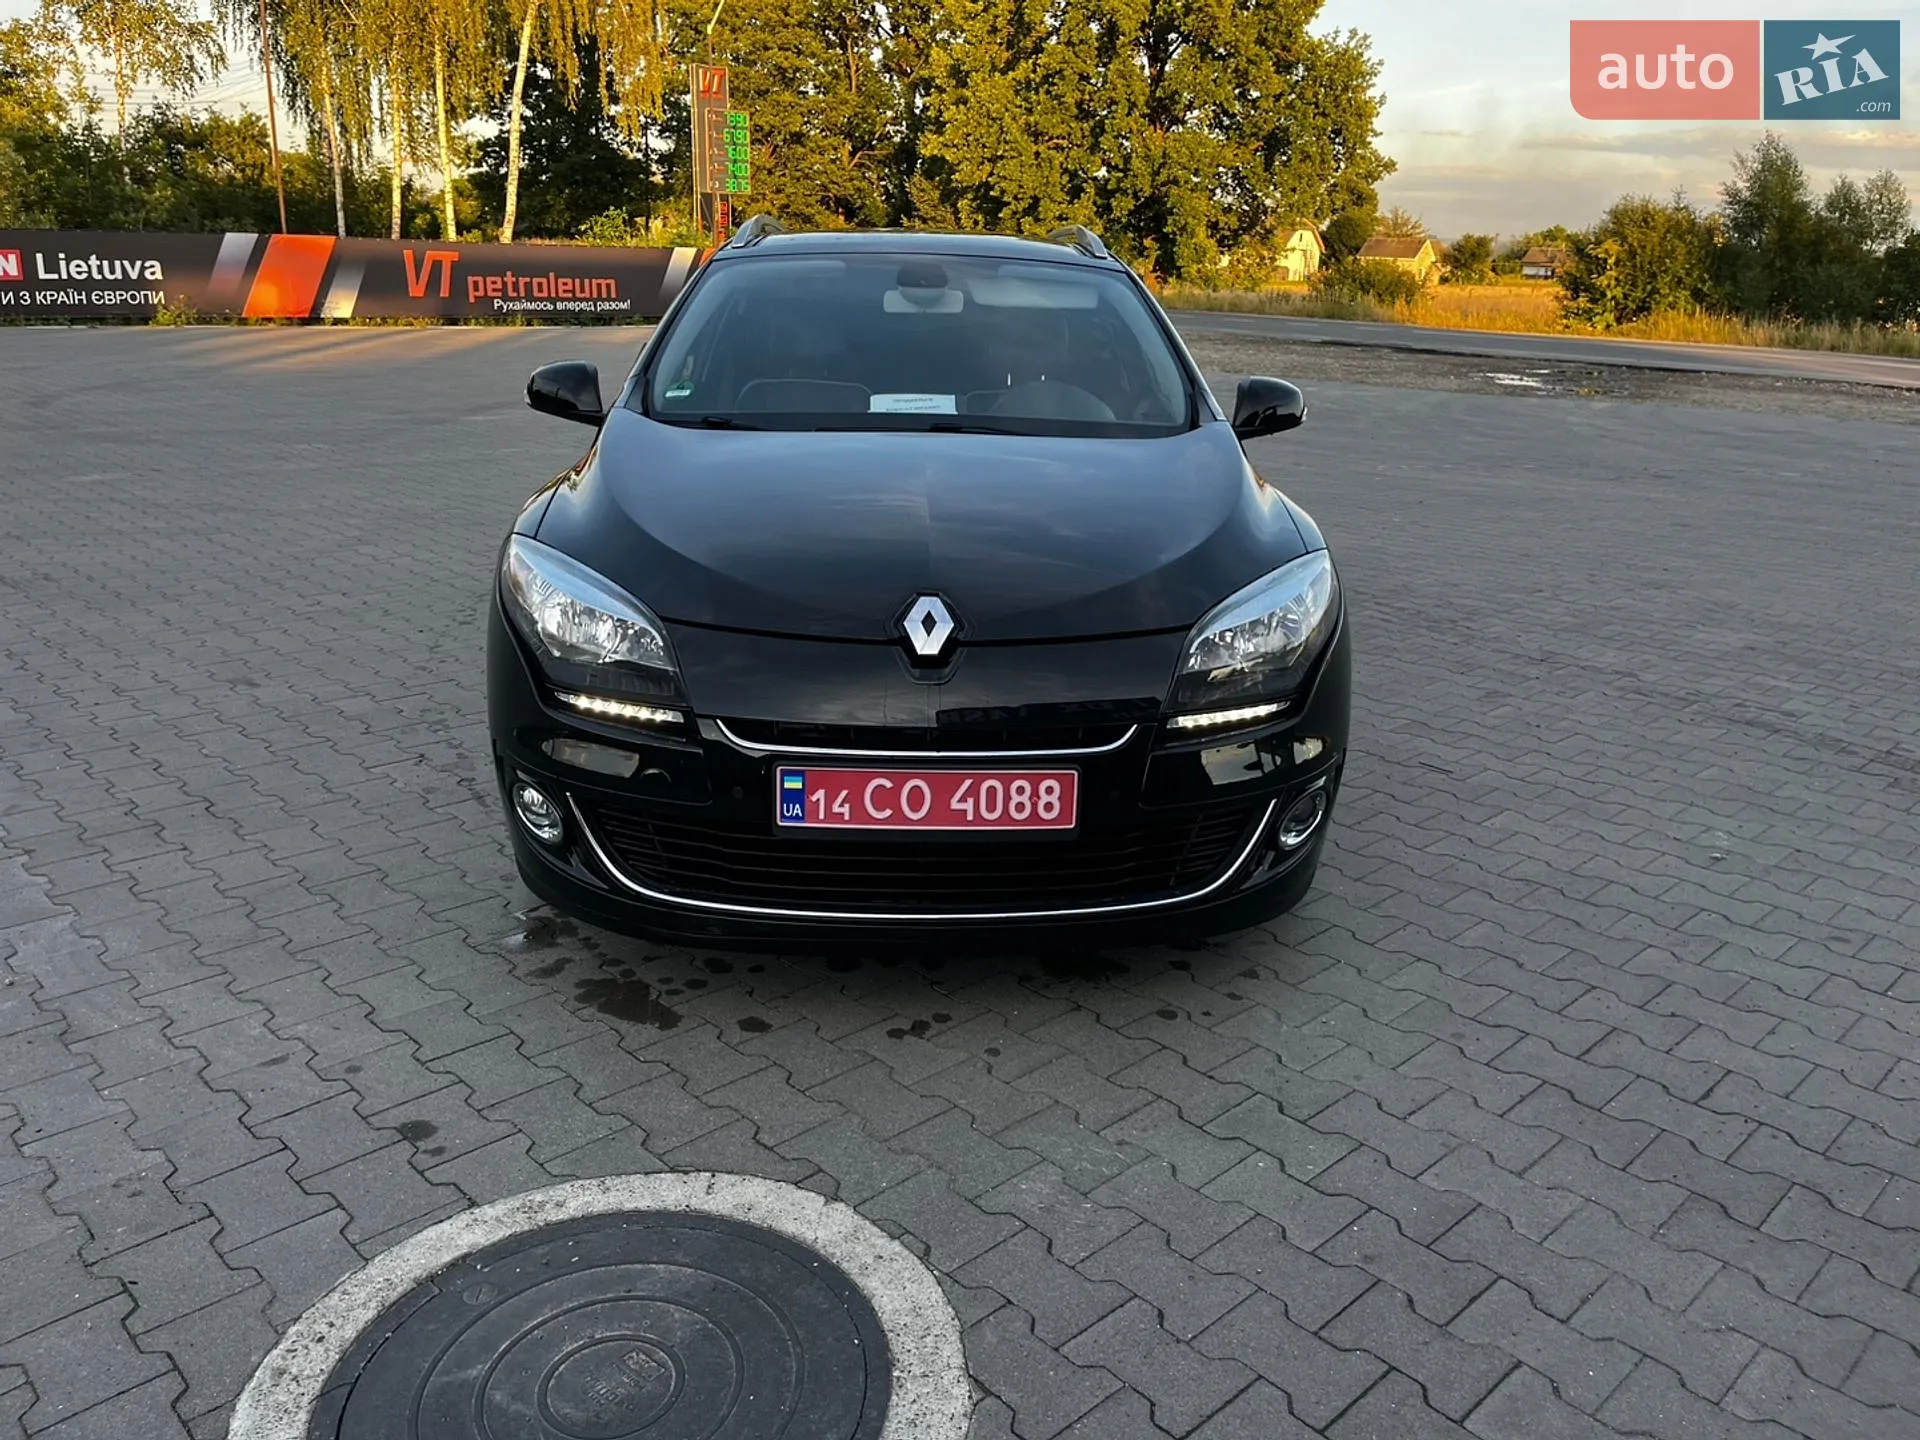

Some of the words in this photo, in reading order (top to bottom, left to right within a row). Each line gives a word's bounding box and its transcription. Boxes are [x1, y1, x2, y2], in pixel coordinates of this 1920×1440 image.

[35, 252, 164, 281] Lietuva
[403, 249, 460, 298] VT
[467, 270, 617, 303] petroleum
[35, 287, 87, 305] КРАЇН
[91, 290, 166, 305] ЄВРОПИ
[493, 298, 554, 313] Рухаймось
[556, 300, 595, 313] вперед
[597, 299, 631, 313] разом!
[783, 803, 803, 818] UA
[809, 788, 851, 821] 14
[863, 777, 933, 821] CO
[950, 778, 1062, 821] 4088
